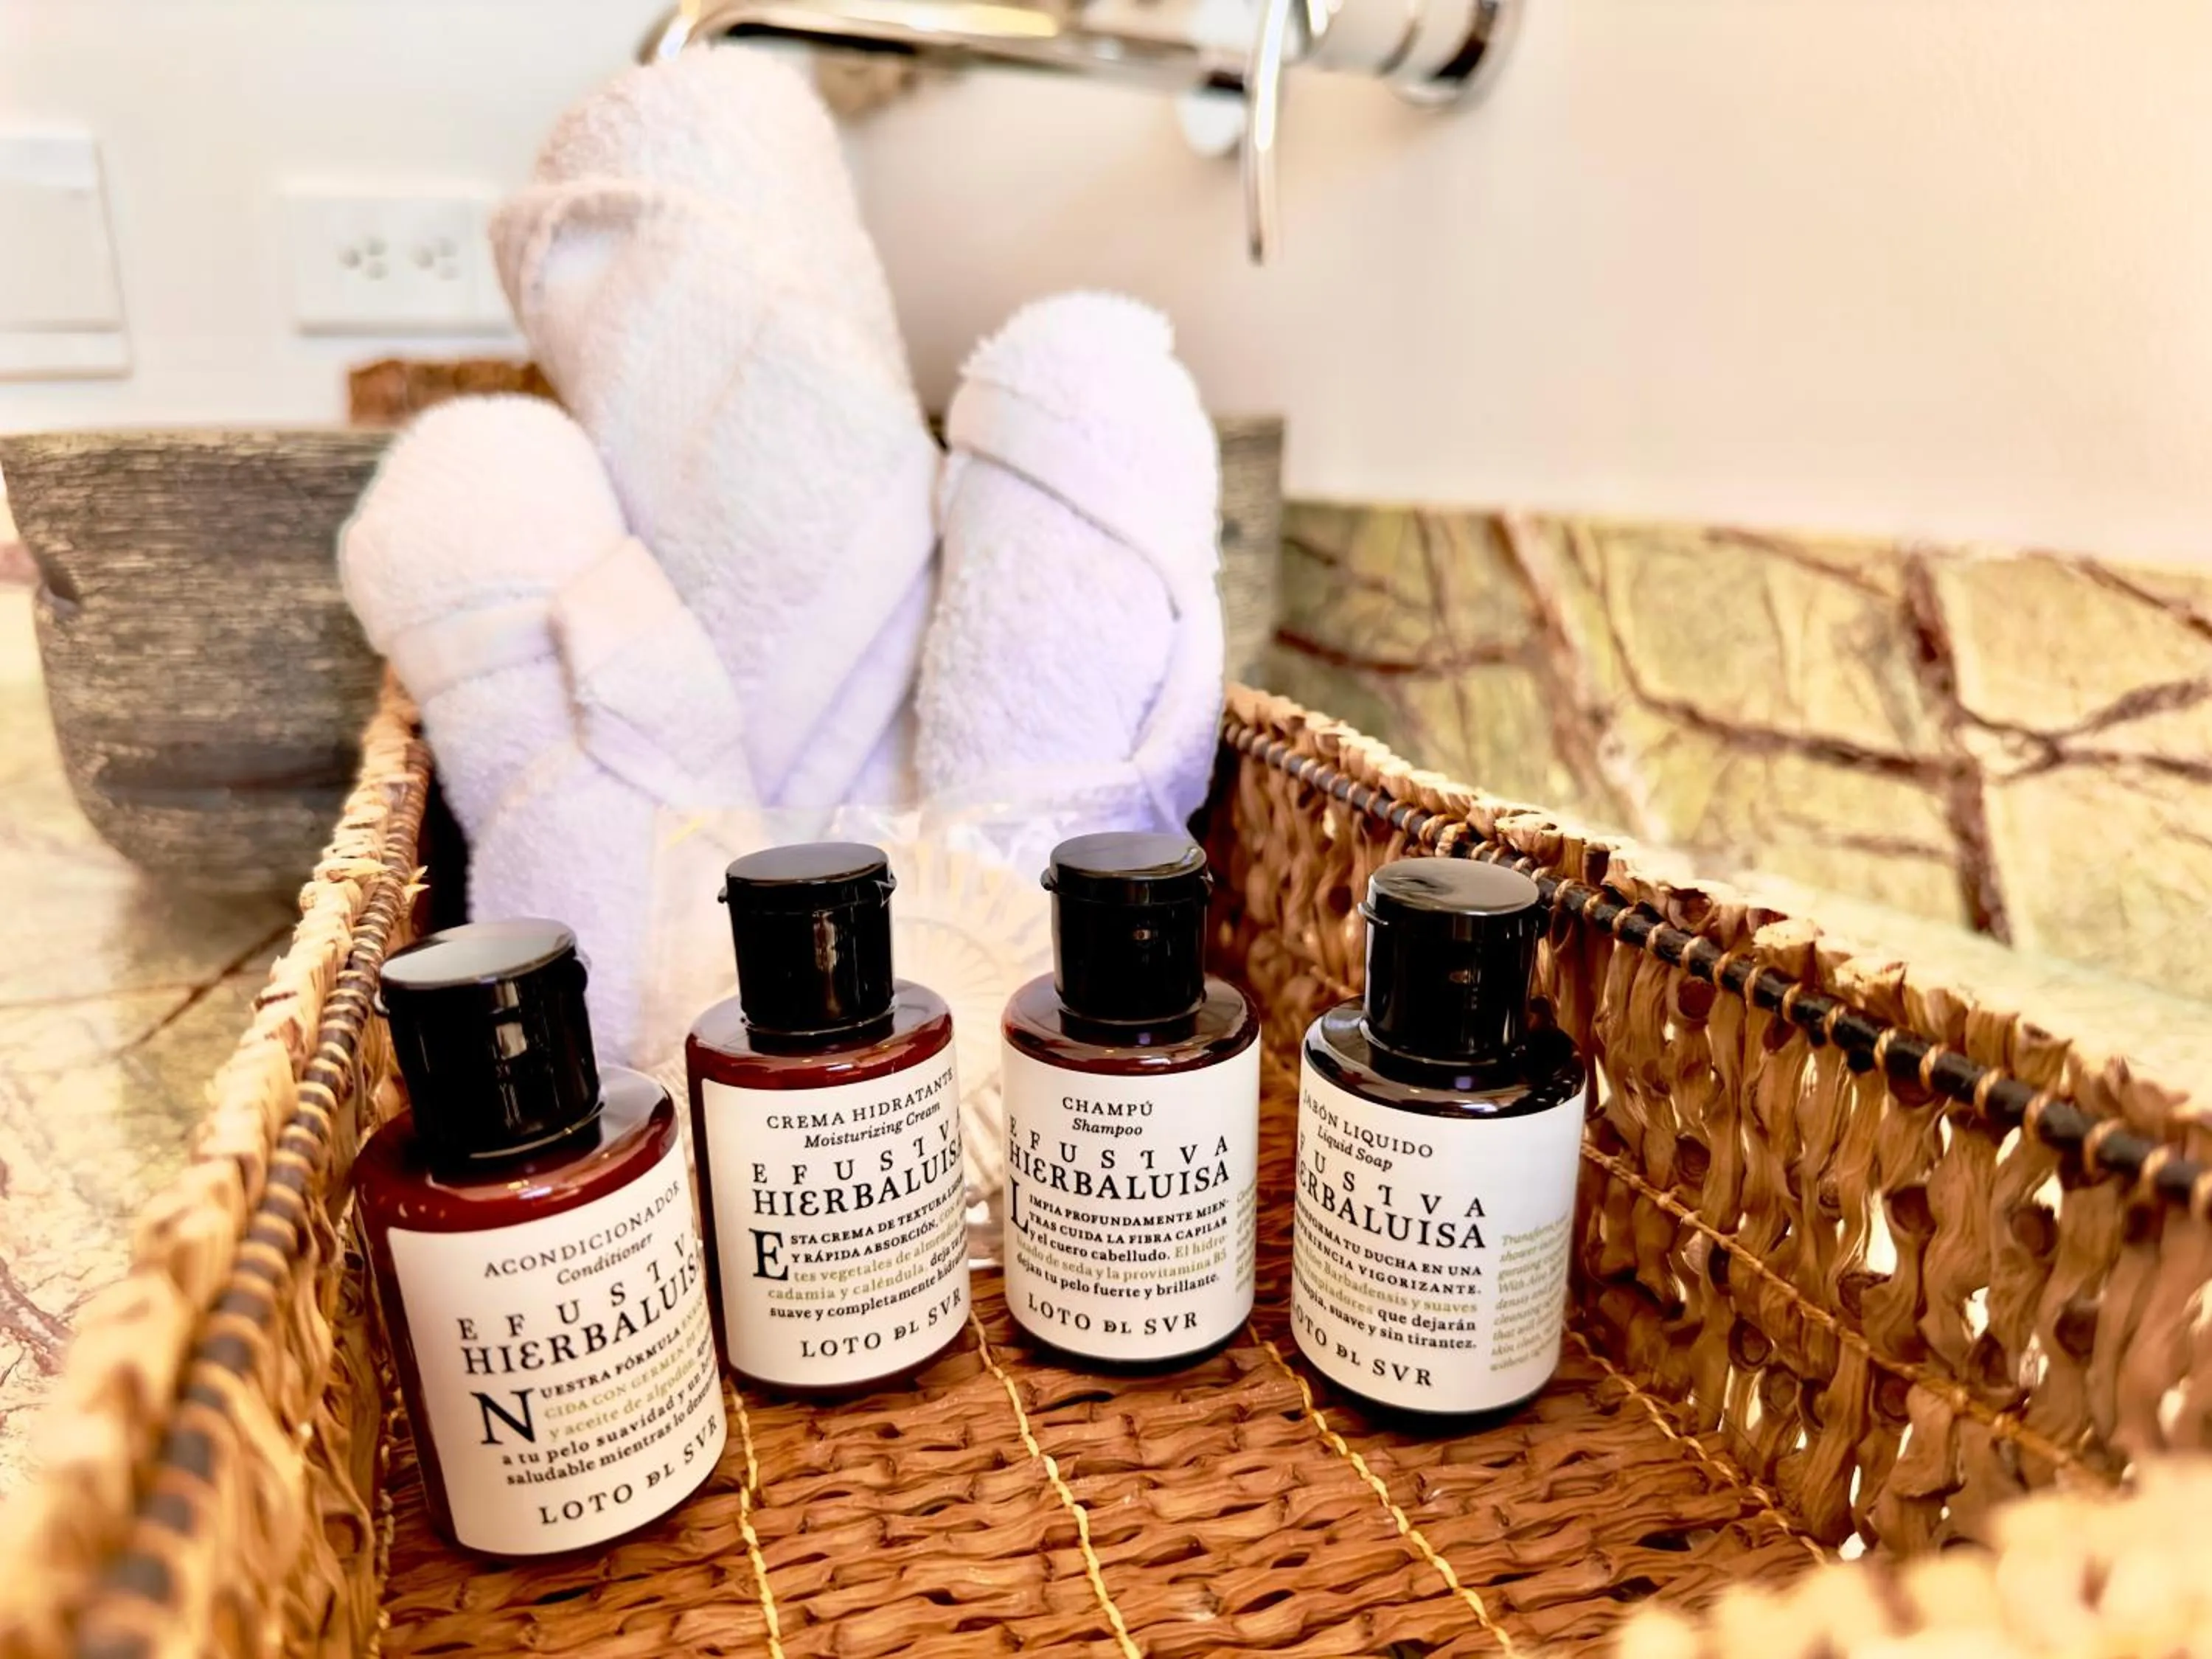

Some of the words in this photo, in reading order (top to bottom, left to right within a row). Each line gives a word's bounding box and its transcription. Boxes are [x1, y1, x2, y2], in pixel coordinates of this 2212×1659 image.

[768, 1113, 844, 1130] CREMA
[852, 1066, 953, 1121] HIDRATANTE
[1062, 1096, 1153, 1116] CHAMPÚ
[804, 1119, 903, 1148] Moisturizing
[906, 1102, 940, 1126] Cream
[1072, 1118, 1143, 1138] Shampoo
[1304, 1089, 1338, 1128] JABÓN
[1343, 1120, 1433, 1158] LIQUIDO
[1318, 1124, 1352, 1156] Liquid
[1355, 1147, 1393, 1172] Soap
[821, 1225, 874, 1244] CREMA
[878, 1219, 896, 1233] DE
[897, 1193, 947, 1226] TEXTURA
[1065, 1209, 1193, 1226] PROFUNDAMENTE
[1197, 1198, 1229, 1217] MIEN-
[1298, 1153, 1485, 1248] ERBALUISA
[484, 1180, 681, 1278] ACONDICIONADOR
[1029, 1212, 1057, 1231] TRAS
[1060, 1225, 1103, 1243] CUIDA
[1107, 1234, 1125, 1244] LA
[1129, 1234, 1172, 1244] FIBRA
[1175, 1218, 1228, 1240] CAPILAR
[1029, 1229, 1035, 1241] y
[1037, 1233, 1047, 1245] el
[1050, 1239, 1088, 1257] cuero
[1091, 1248, 1171, 1262] cabelludo.
[1175, 1246, 1189, 1259] El
[557, 1232, 654, 1285] Conditioner
[768, 1289, 835, 1300] cadamia
[840, 1288, 849, 1299] y
[931, 1248, 950, 1267] deja
[791, 1254, 800, 1263] Y
[804, 1248, 860, 1264] RÁPIDA
[794, 1271, 815, 1281] tes
[820, 1258, 892, 1282] vegetales
[896, 1250, 911, 1264] de
[1046, 1253, 1059, 1267] de
[1062, 1260, 1092, 1278] seda
[1095, 1267, 1103, 1280] y
[1107, 1265, 1120, 1279] la
[1123, 1259, 1211, 1282] provitamina
[1343, 1237, 1360, 1254] TU
[1364, 1248, 1417, 1271] DUCHA
[1422, 1263, 1443, 1276] EN
[1447, 1265, 1482, 1277] UNA
[771, 1307, 811, 1318] suave
[815, 1308, 824, 1321] y
[827, 1276, 936, 1318] completamente
[1045, 1270, 1057, 1284] tu
[1060, 1276, 1090, 1293] pelo
[1094, 1283, 1141, 1297] fuerte
[1144, 1290, 1152, 1299] y
[1156, 1272, 1220, 1296] brillante.
[1304, 1263, 1374, 1315] limpiadores
[1377, 1307, 1408, 1325] que
[1411, 1314, 1477, 1333] dejarán
[1324, 1261, 1408, 1307] Barbadensis
[1411, 1299, 1420, 1311] y
[1425, 1300, 1478, 1313] suaves
[1358, 1264, 1482, 1295] VIGORIZANTE.
[461, 1246, 700, 1374] HIERBALUIS
[1028, 1292, 1091, 1331] LOTO
[1292, 1301, 1326, 1346] OTO
[1329, 1304, 1366, 1330] suave
[1368, 1324, 1377, 1336] y
[1380, 1326, 1403, 1342] sin
[1408, 1333, 1478, 1350] tirantez.
[616, 1328, 681, 1375] FÓRMULA
[801, 1332, 881, 1357] LOTO
[544, 1396, 589, 1420] CIDA
[592, 1382, 627, 1406] CON
[631, 1346, 686, 1388] GERMEN
[502, 1454, 513, 1465] a
[519, 1450, 540, 1464] tu
[546, 1439, 590, 1463] pelo
[597, 1396, 675, 1447] suavidad
[677, 1390, 686, 1405] y
[548, 1427, 560, 1441] y
[565, 1409, 620, 1435] aceite
[624, 1396, 644, 1414] de
[507, 1459, 594, 1486] saludable
[600, 1422, 673, 1467] mientras
[673, 1410, 686, 1427] lo
[538, 1483, 633, 1525] LOTO
